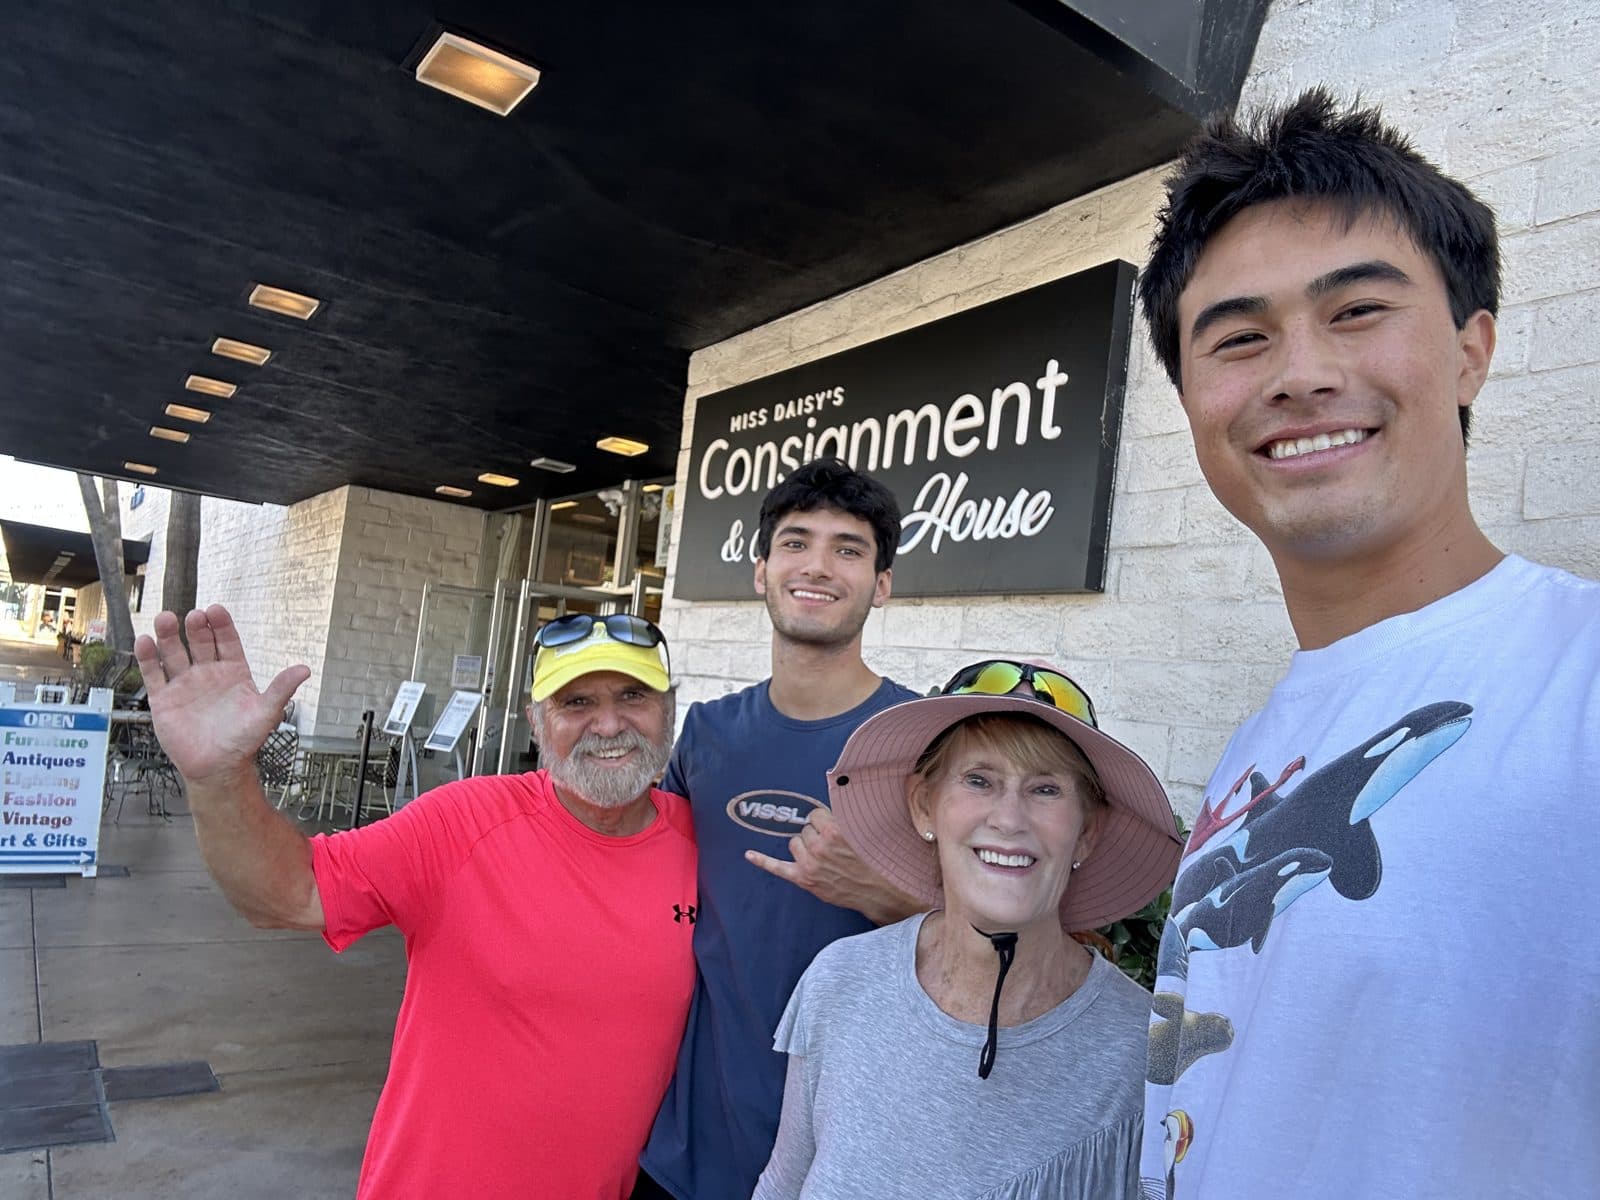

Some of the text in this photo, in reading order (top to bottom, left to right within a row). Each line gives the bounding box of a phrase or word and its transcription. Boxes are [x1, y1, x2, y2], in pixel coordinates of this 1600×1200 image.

[730, 386, 845, 433] MISS DAISY'S
[721, 519, 744, 562] &
[896, 472, 1055, 554] House
[23, 712, 75, 729] OPEN
[5, 731, 89, 749] Furture
[2, 751, 86, 770] Antiques
[4, 771, 80, 791] Lighng
[3, 791, 77, 807] Fashion
[3, 811, 73, 829] Vintage
[739, 800, 810, 825] VISSL
[0, 833, 87, 847] rt & Gifts
